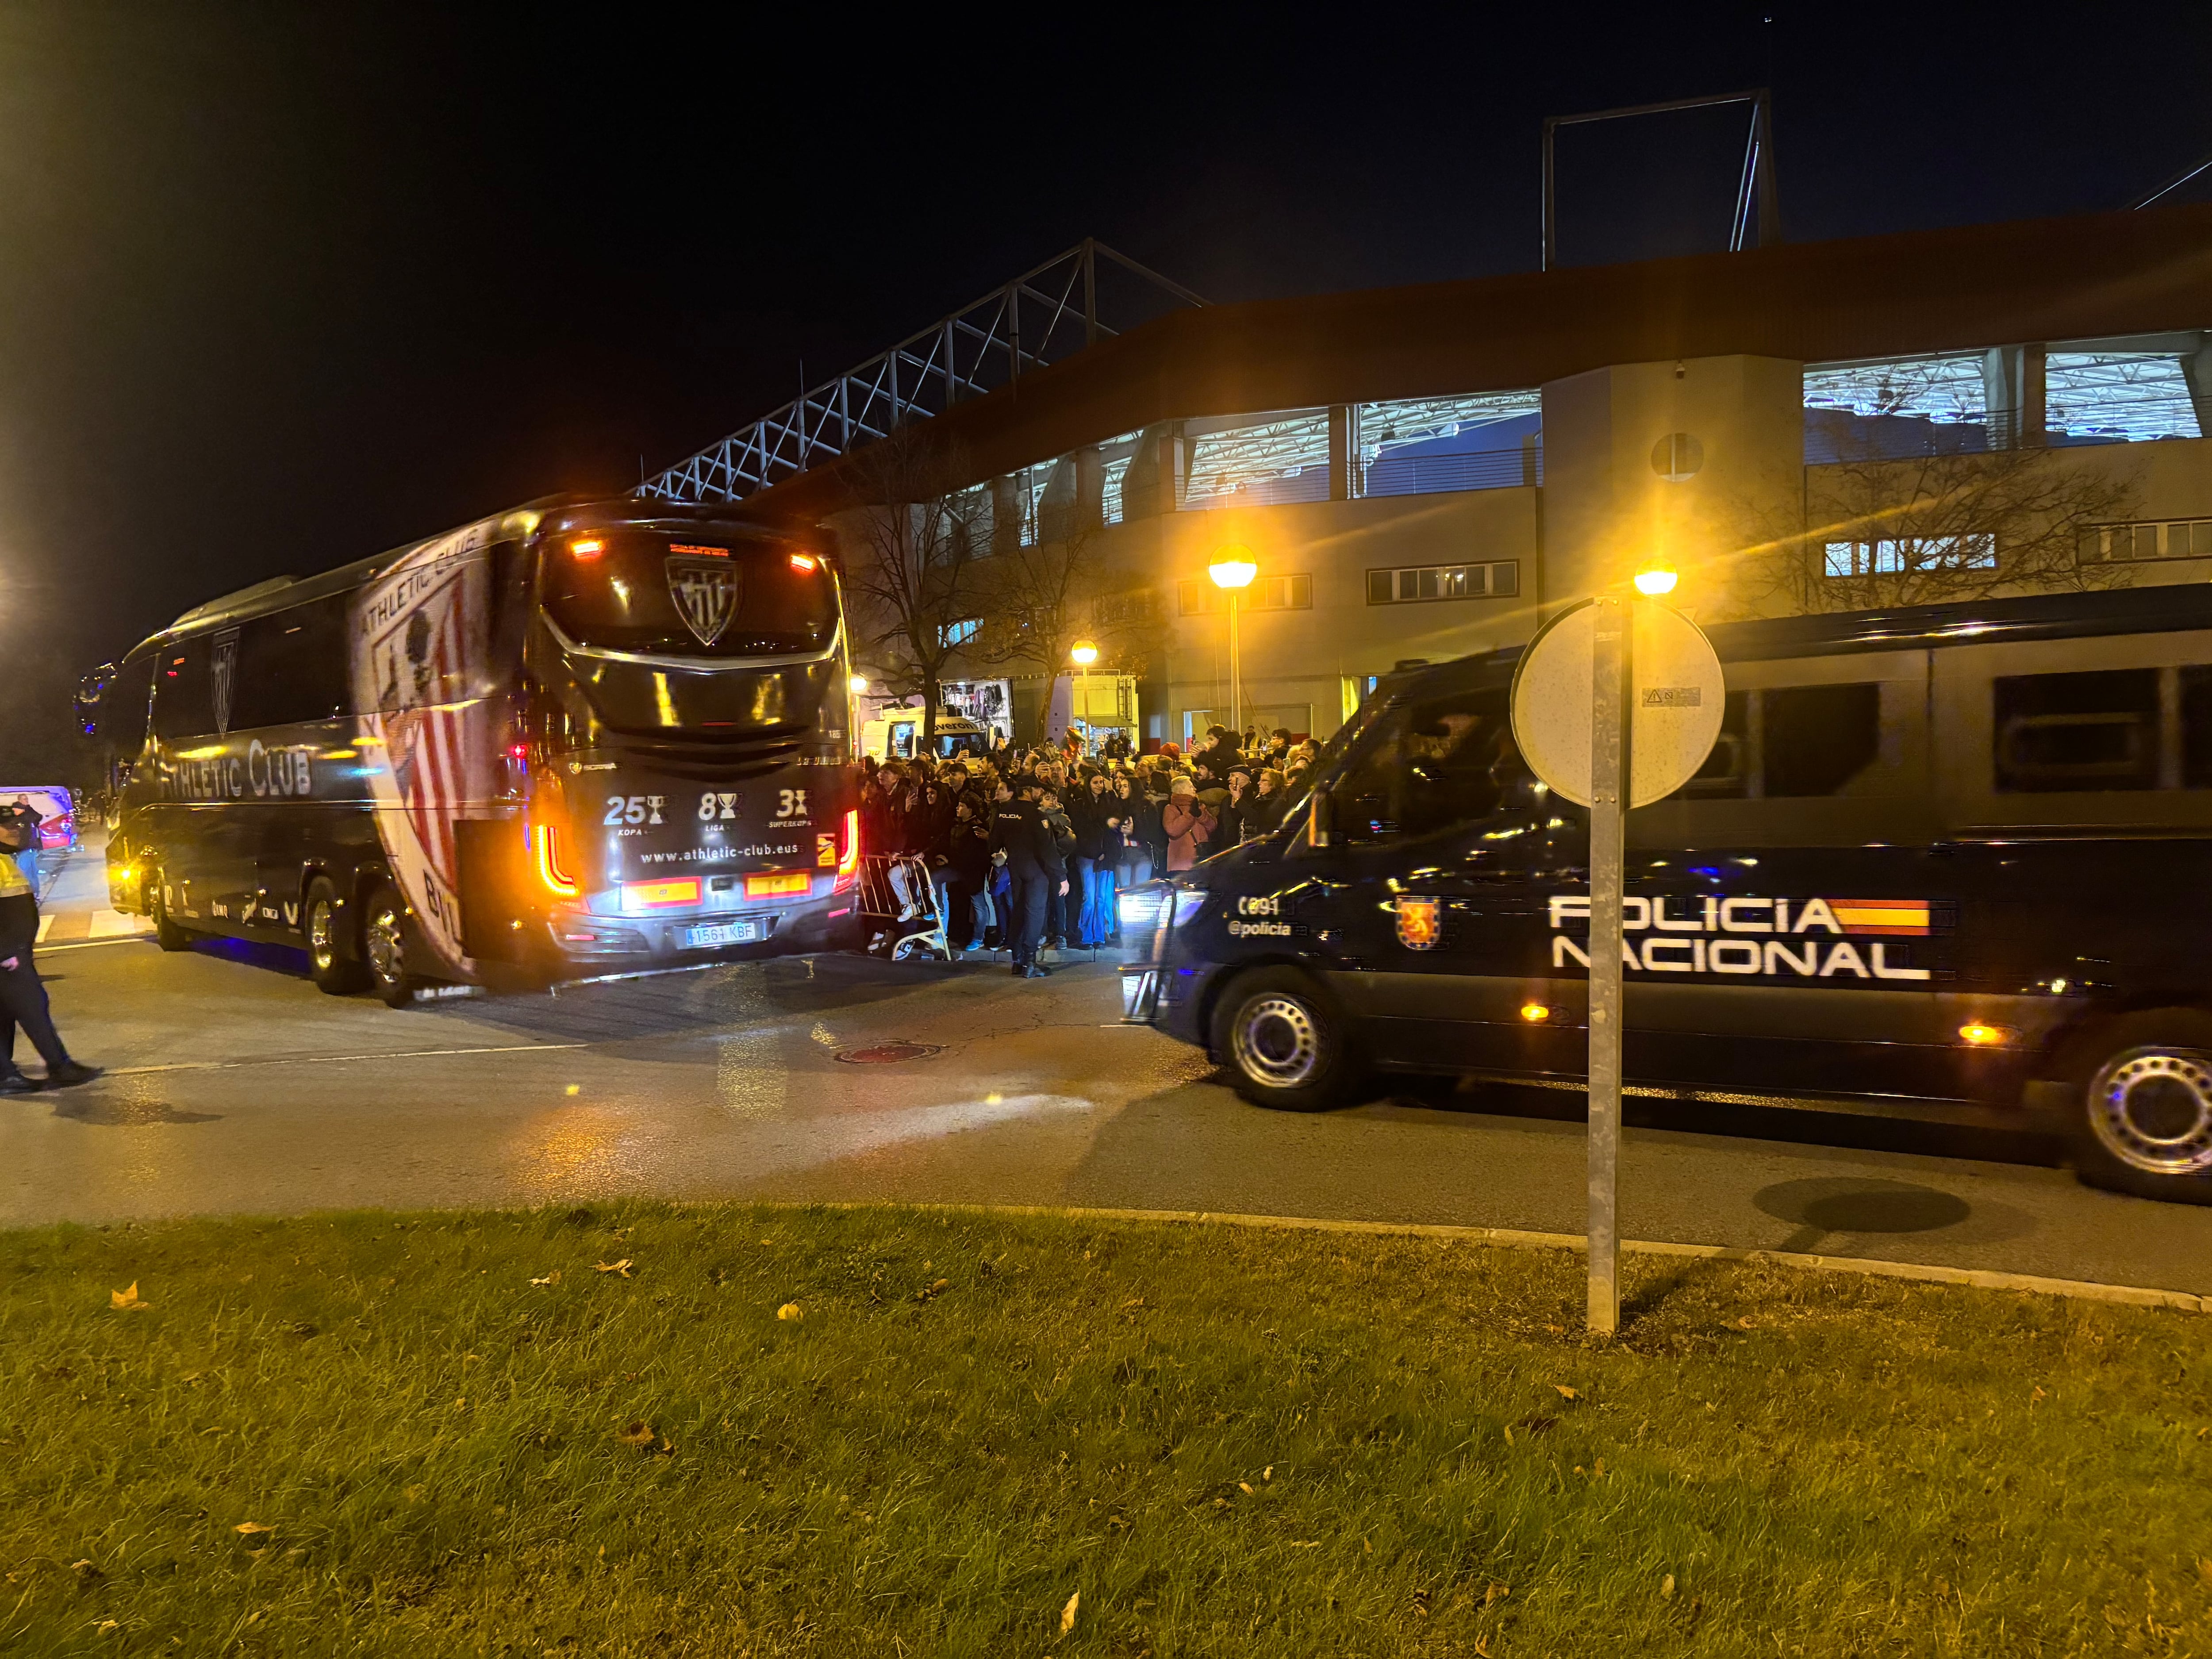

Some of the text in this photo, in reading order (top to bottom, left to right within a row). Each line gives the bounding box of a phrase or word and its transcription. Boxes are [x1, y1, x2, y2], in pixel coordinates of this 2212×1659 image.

[249, 739, 311, 796] CLUB
[603, 796, 646, 825] 25
[698, 793, 717, 821] 8
[641, 844, 799, 864] www.athletic-club.eus
[730, 925, 753, 938] KBF
